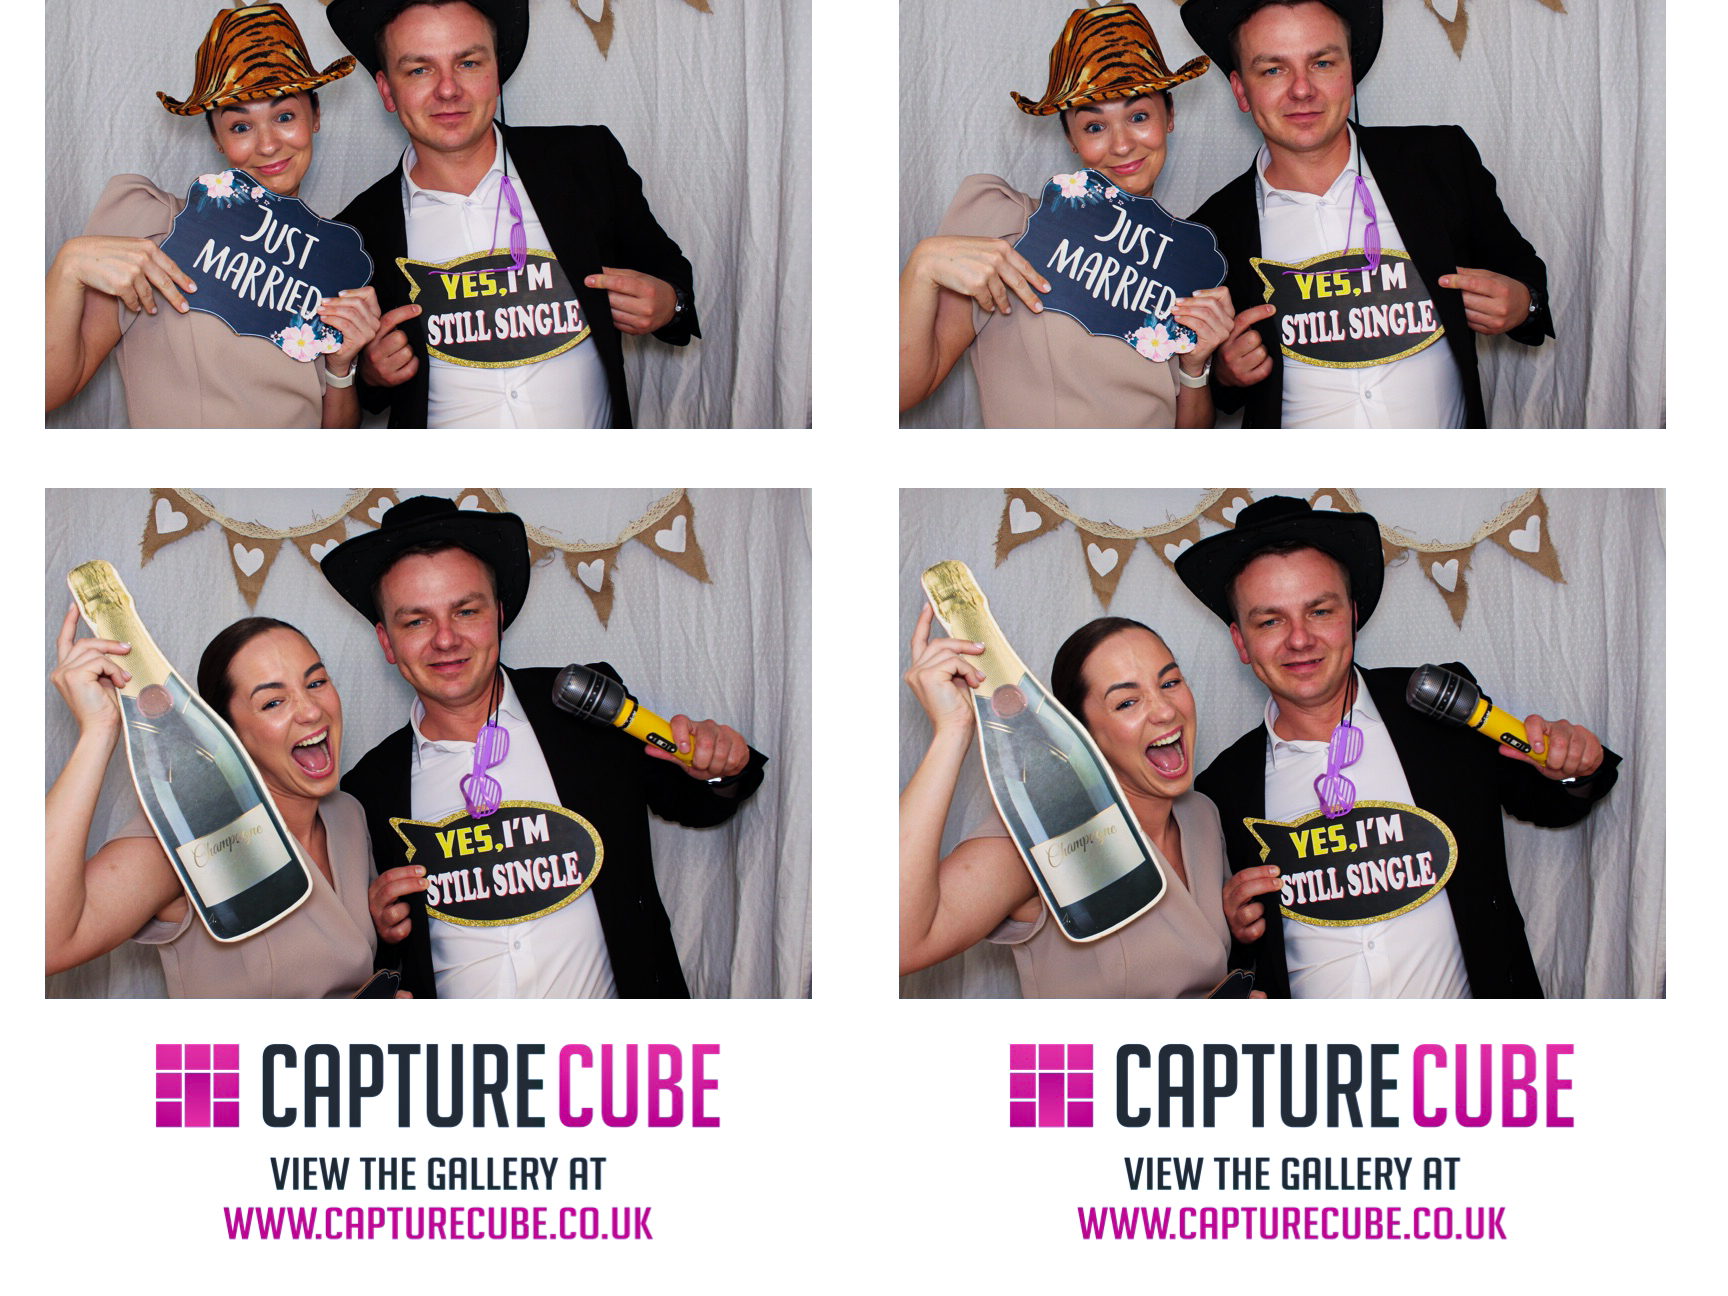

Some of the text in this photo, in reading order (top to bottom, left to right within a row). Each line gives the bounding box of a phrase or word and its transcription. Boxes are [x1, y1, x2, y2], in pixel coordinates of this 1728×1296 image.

[240, 204, 320, 269] JUST
[1094, 204, 1174, 269] JUST
[192, 238, 322, 320] MARRIED
[1046, 238, 1176, 320] MARRIED
[427, 299, 583, 346] STILL SINGLE
[1281, 299, 1437, 346] STILL SINGLE
[426, 851, 582, 906] STILL SINGLE
[1280, 851, 1436, 906] STILL SINGLE
